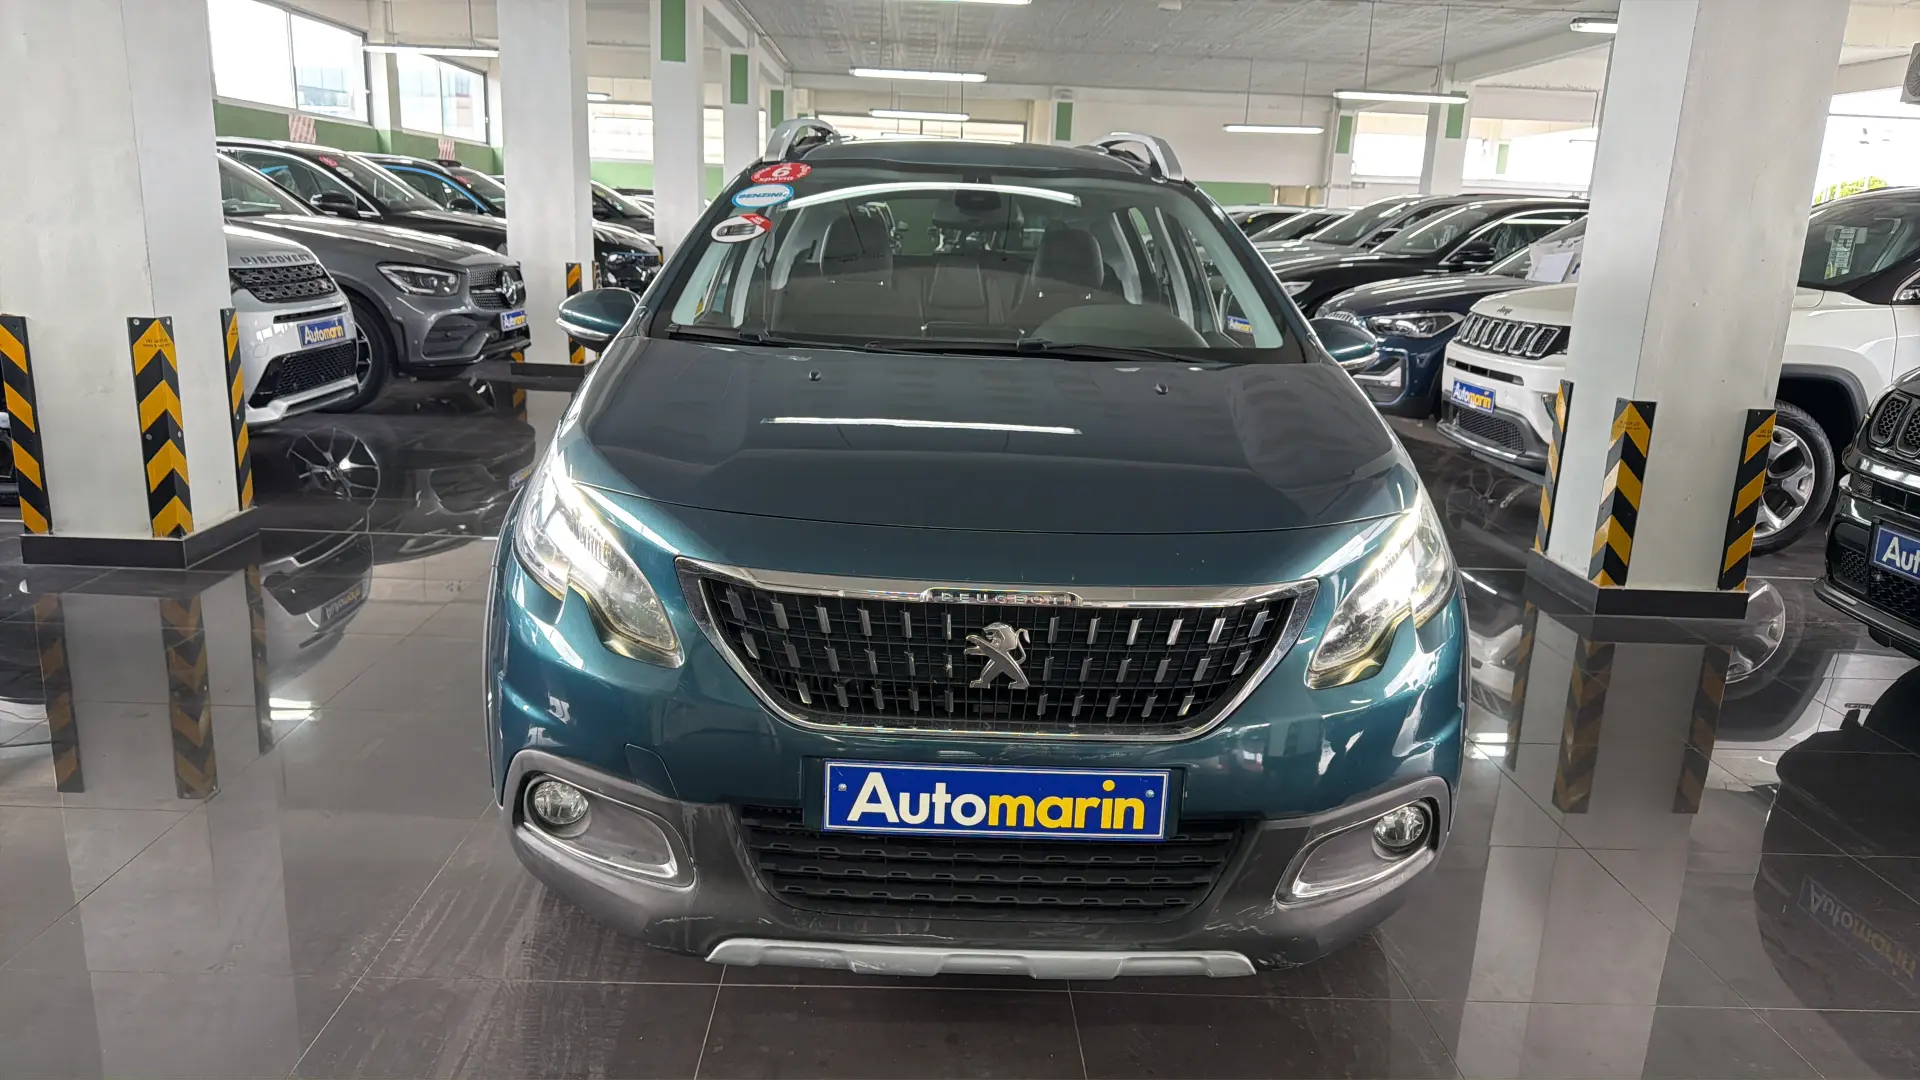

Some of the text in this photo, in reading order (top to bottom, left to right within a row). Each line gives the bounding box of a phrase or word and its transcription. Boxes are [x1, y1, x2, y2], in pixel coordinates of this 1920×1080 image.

[772, 166, 792, 178] 6
[304, 317, 344, 345] Automarin
[1453, 382, 1491, 409] Automarin
[847, 771, 1146, 830] Automarin
